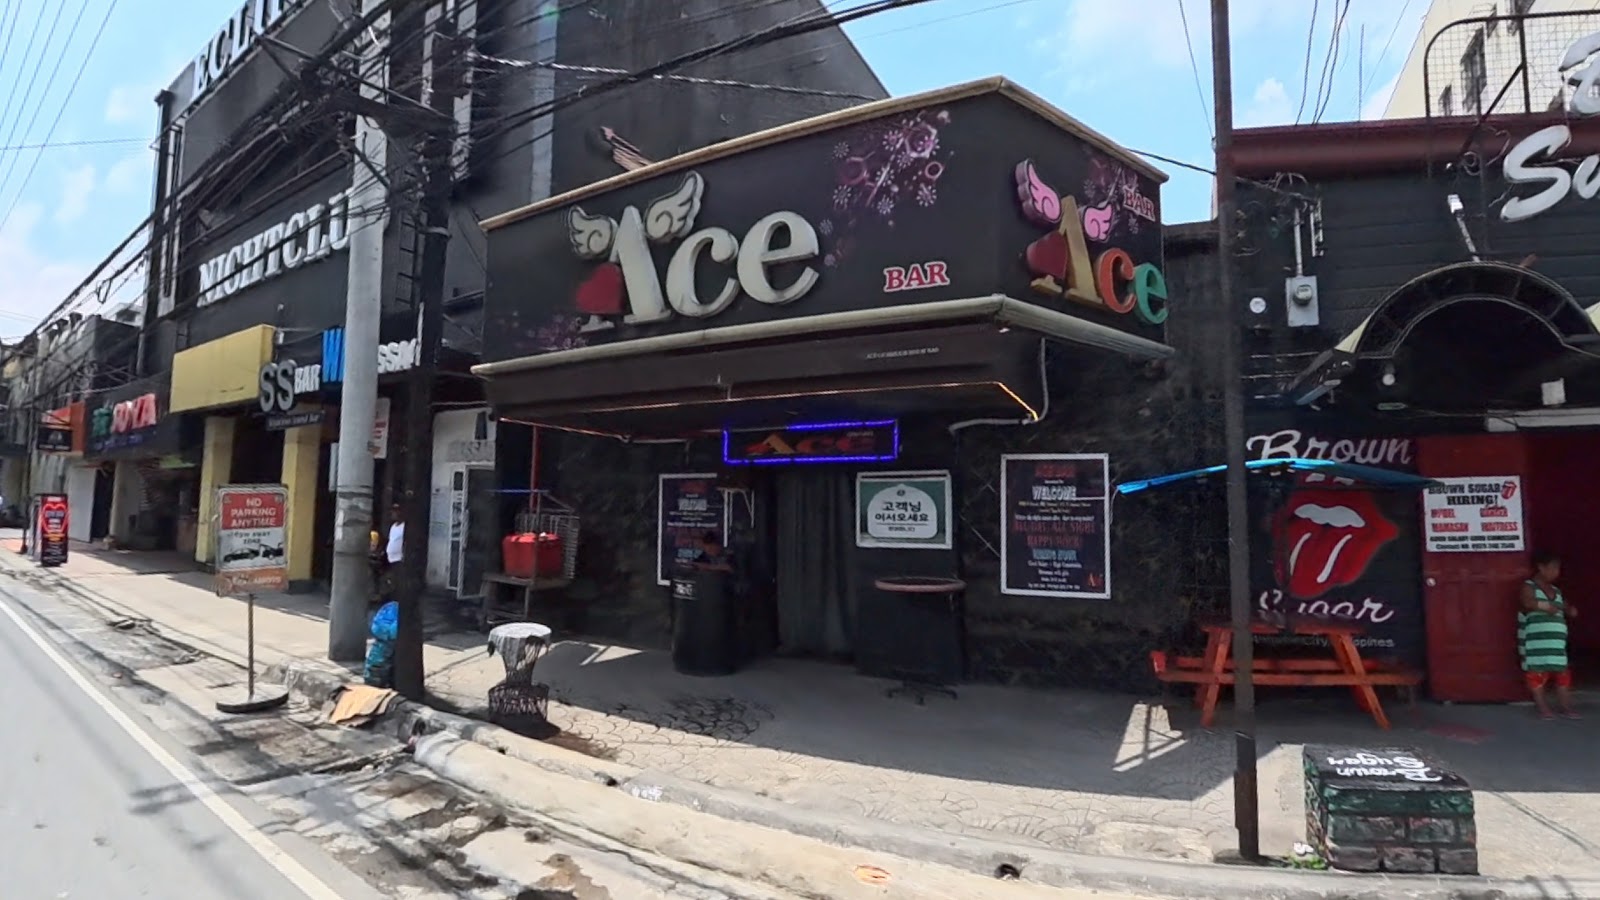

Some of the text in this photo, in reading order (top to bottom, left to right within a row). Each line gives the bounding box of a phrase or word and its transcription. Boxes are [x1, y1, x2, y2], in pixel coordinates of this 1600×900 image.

[1122, 187, 1155, 222] BAR
[197, 186, 390, 307] NIGHTCLU
[579, 205, 820, 332] Ace
[1029, 195, 1168, 325] Ace
[884, 262, 950, 292] BAR
[322, 326, 345, 383] W
[260, 360, 321, 412] SS BAR
[1246, 429, 1411, 472] Brown
[246, 498, 262, 507] NO
[1032, 486, 1077, 500] WELCOME
[1446, 494, 1499, 506] HIRING!
[230, 507, 276, 517] PARKING
[875, 513, 928, 522] 어서오세요
[882, 501, 921, 512] 고객님
[231, 517, 276, 527] ANYTIME
[1336, 766, 1443, 783] Brown
